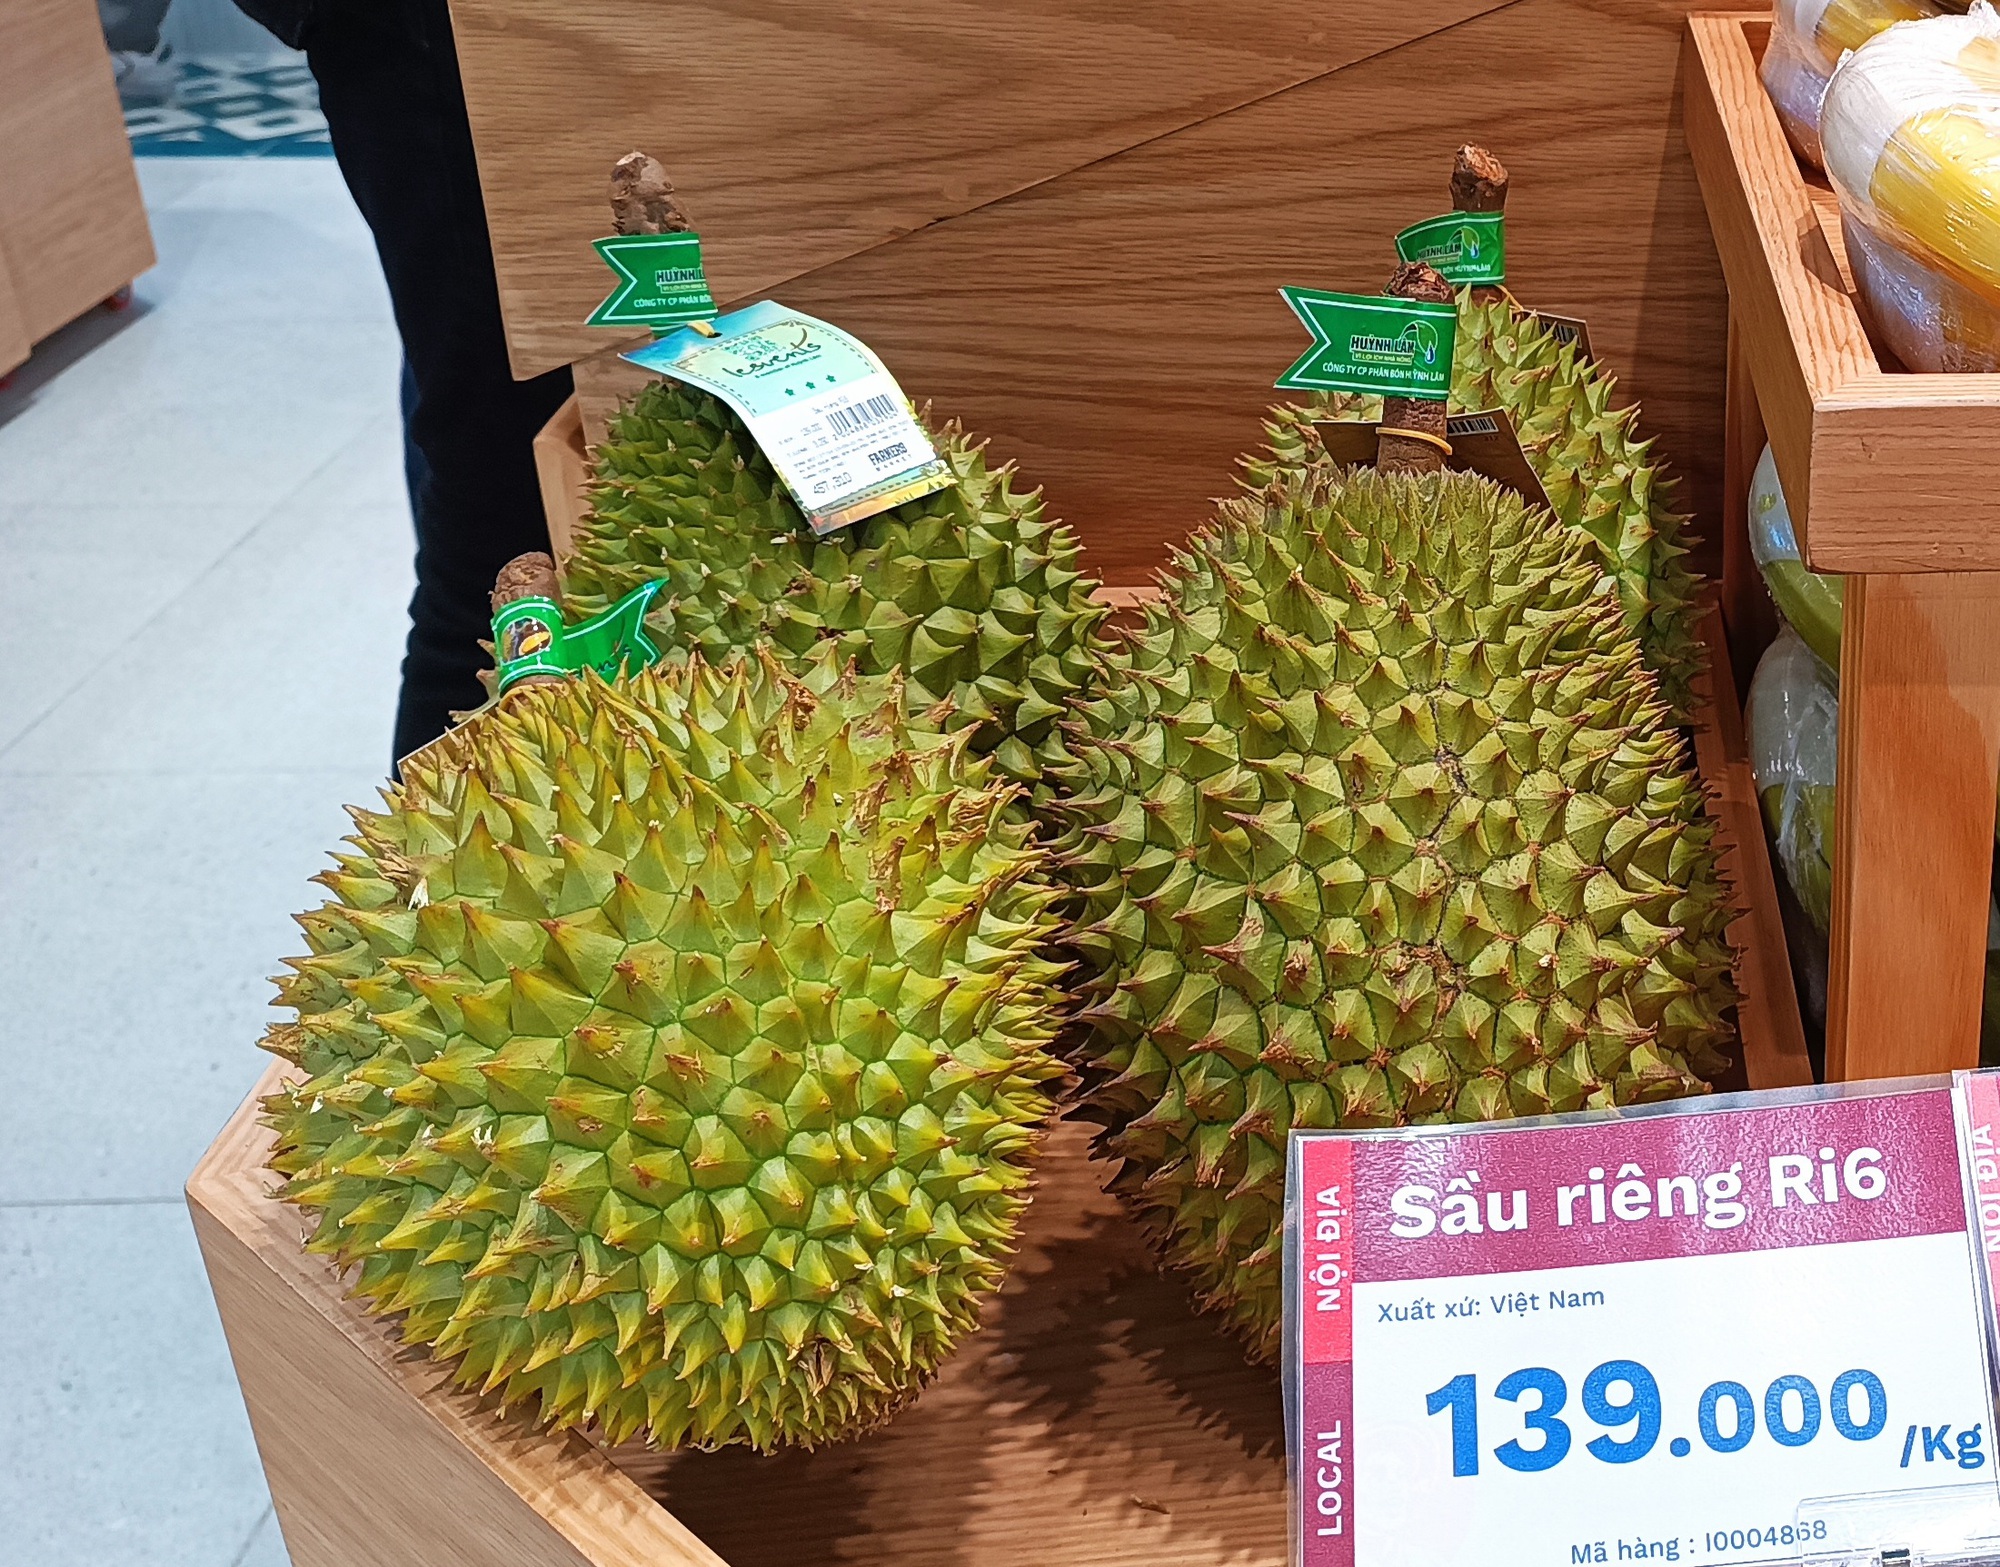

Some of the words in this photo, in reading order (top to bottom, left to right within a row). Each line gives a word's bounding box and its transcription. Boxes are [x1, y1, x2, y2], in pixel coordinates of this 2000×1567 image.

[634, 297, 656, 308] CÔNG
[1350, 333, 1392, 352] HUỲNH
[1322, 361, 1345, 374] CÔNG
[1346, 364, 1356, 374] TY
[1357, 365, 1367, 376] CP
[1368, 366, 1390, 378] PHÂN
[1390, 368, 1404, 379] BÓN
[1315, 1184, 1349, 1244] ĐỊA
[1389, 1169, 1529, 1240] Sầu
[1556, 1161, 1746, 1230] riêng
[1768, 1146, 1887, 1209] Ri6
[1307, 1252, 1349, 1313] NỘI
[1378, 1297, 1436, 1323] Xuất
[1445, 1296, 1481, 1319] xứ:
[1490, 1291, 1540, 1318] Việt
[1549, 1289, 1605, 1310] Nam
[1425, 1359, 1888, 1478] 139.000
[1900, 1423, 1985, 1470] /Kg
[1316, 1419, 1343, 1537] LOCAL
[1571, 1540, 1609, 1565] Mã
[1617, 1537, 1681, 1562] hàng
